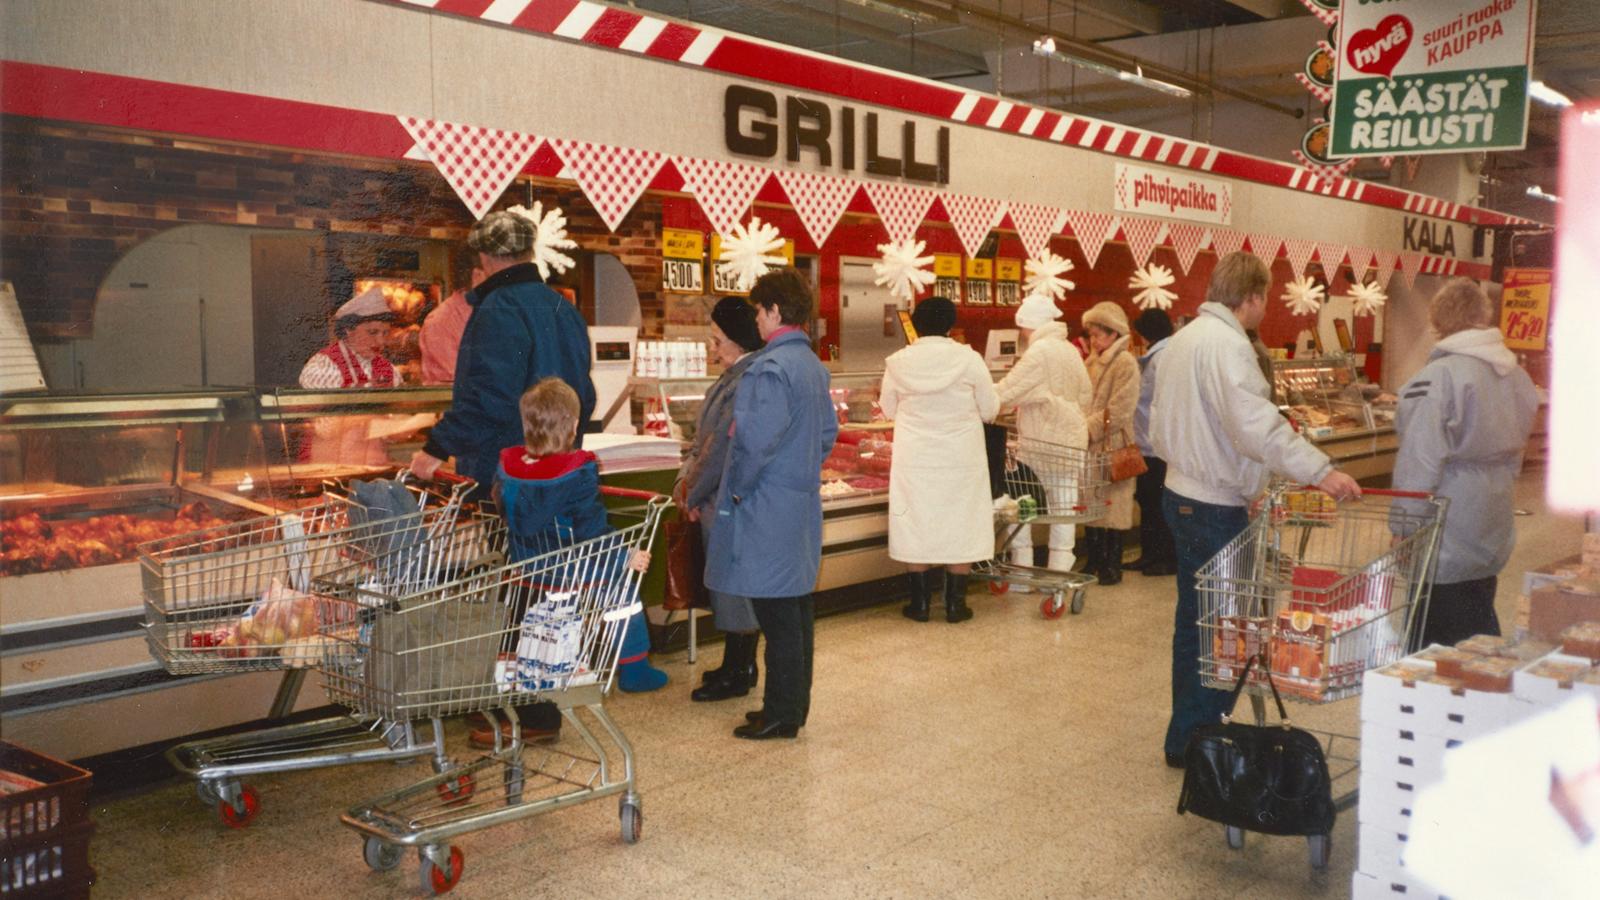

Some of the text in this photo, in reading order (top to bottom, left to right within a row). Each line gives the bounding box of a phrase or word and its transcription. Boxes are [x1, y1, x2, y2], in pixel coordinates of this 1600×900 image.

[1353, 21, 1409, 68] hyvä
[1423, 13, 1463, 46] suuri
[1427, 19, 1504, 66] KAUPPA
[1354, 73, 1509, 118] SÄÄSTÄT
[724, 84, 950, 185] GRILLI
[1351, 112, 1494, 149] REILUSTI
[1134, 174, 1217, 212] pihvipaikka
[1403, 216, 1456, 257] KALA
